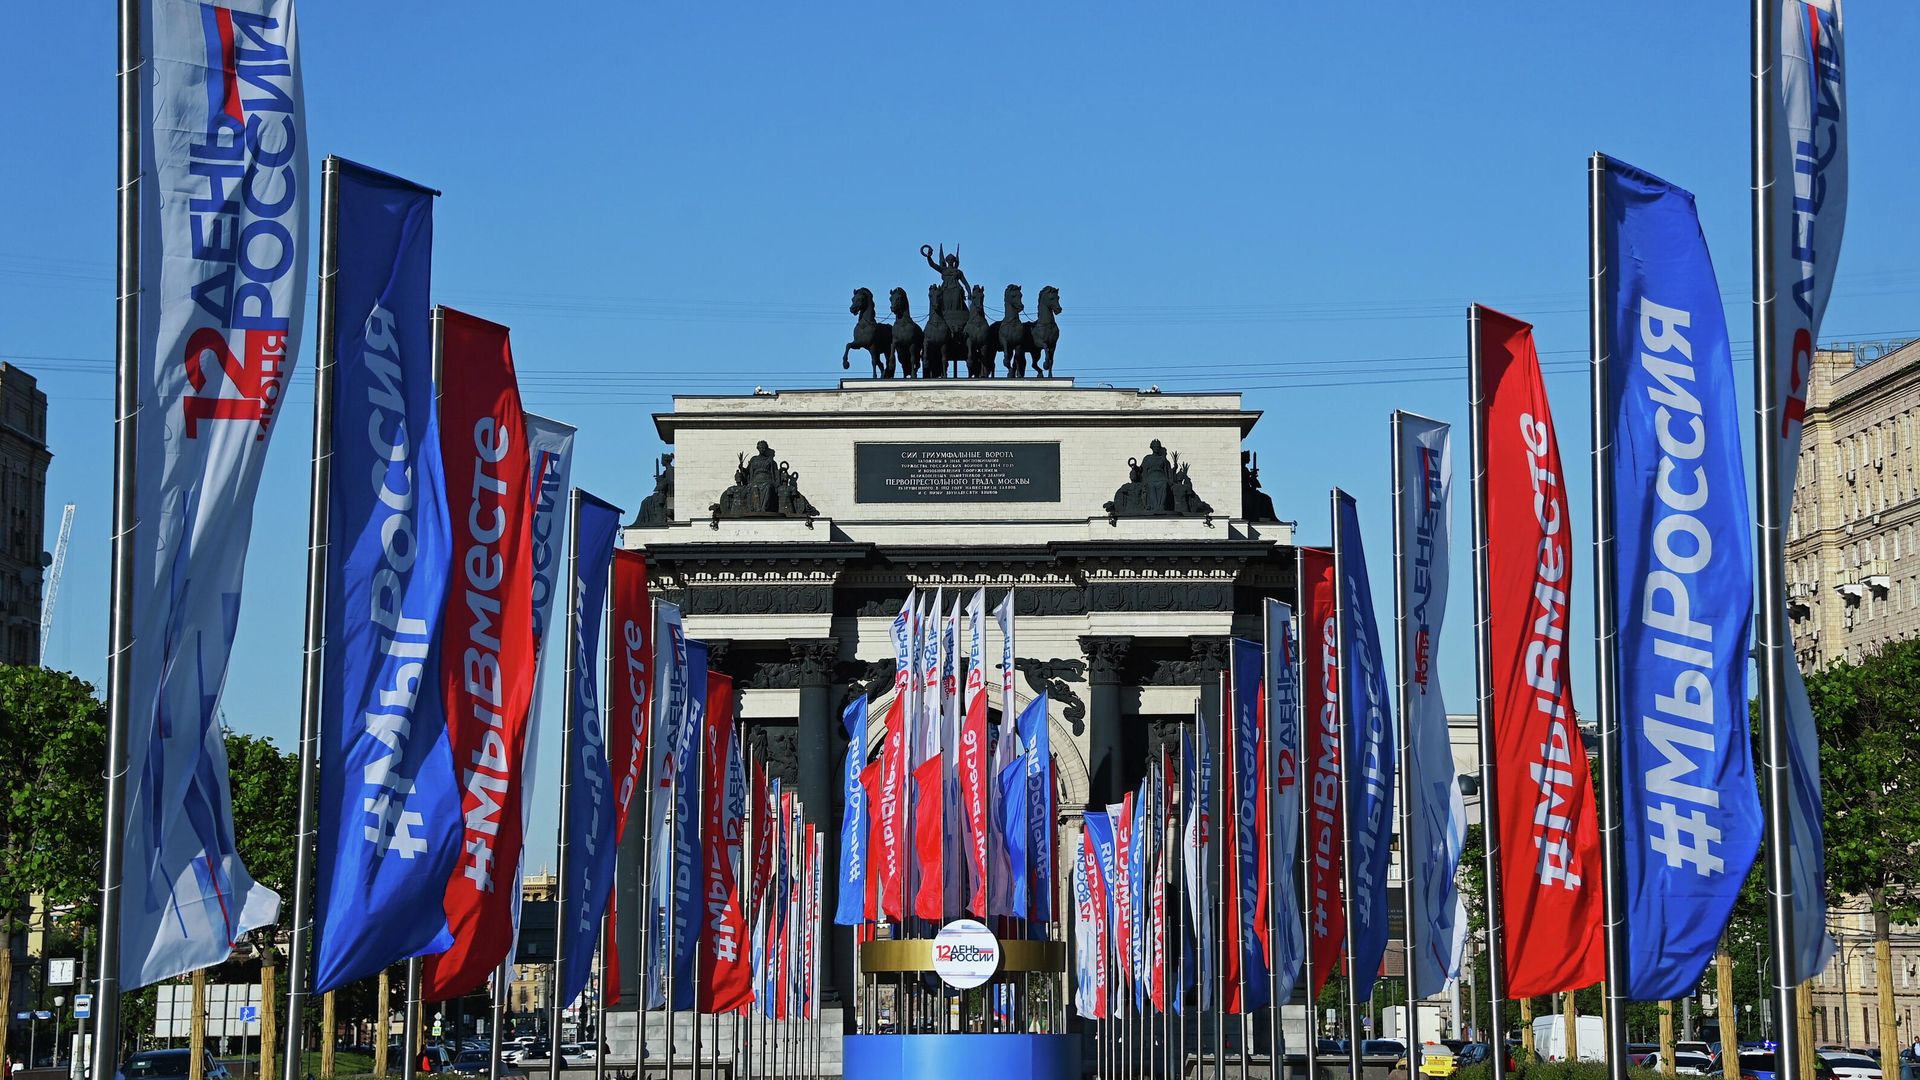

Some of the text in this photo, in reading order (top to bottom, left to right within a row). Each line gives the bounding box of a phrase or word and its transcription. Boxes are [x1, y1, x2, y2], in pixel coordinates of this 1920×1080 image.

[233, 7, 295, 331] РОССИИ
[184, 118, 263, 439] 12 ДЕНЬ
[362, 298, 428, 860] #МыРоссия
[463, 416, 510, 896] #МыВместе
[1412, 515, 1430, 631] ДЕНЬ
[1519, 412, 1582, 891] #МыВместе
[1640, 296, 1726, 878] #МыРоссия
[577, 574, 603, 934] Россия
[619, 618, 645, 811] Вместе
[667, 668, 682, 751] ДЕНЬ
[729, 753, 740, 818] ДЕНЬ
[1277, 749, 1296, 795] 12
[1278, 669, 1293, 749] ДЕНЬ
[1349, 574, 1385, 928] #МыРоссия
[727, 817, 742, 846] 12
[936, 944, 980, 959] 12 ДЕНЬ
[951, 953, 994, 962] РОССИИ
